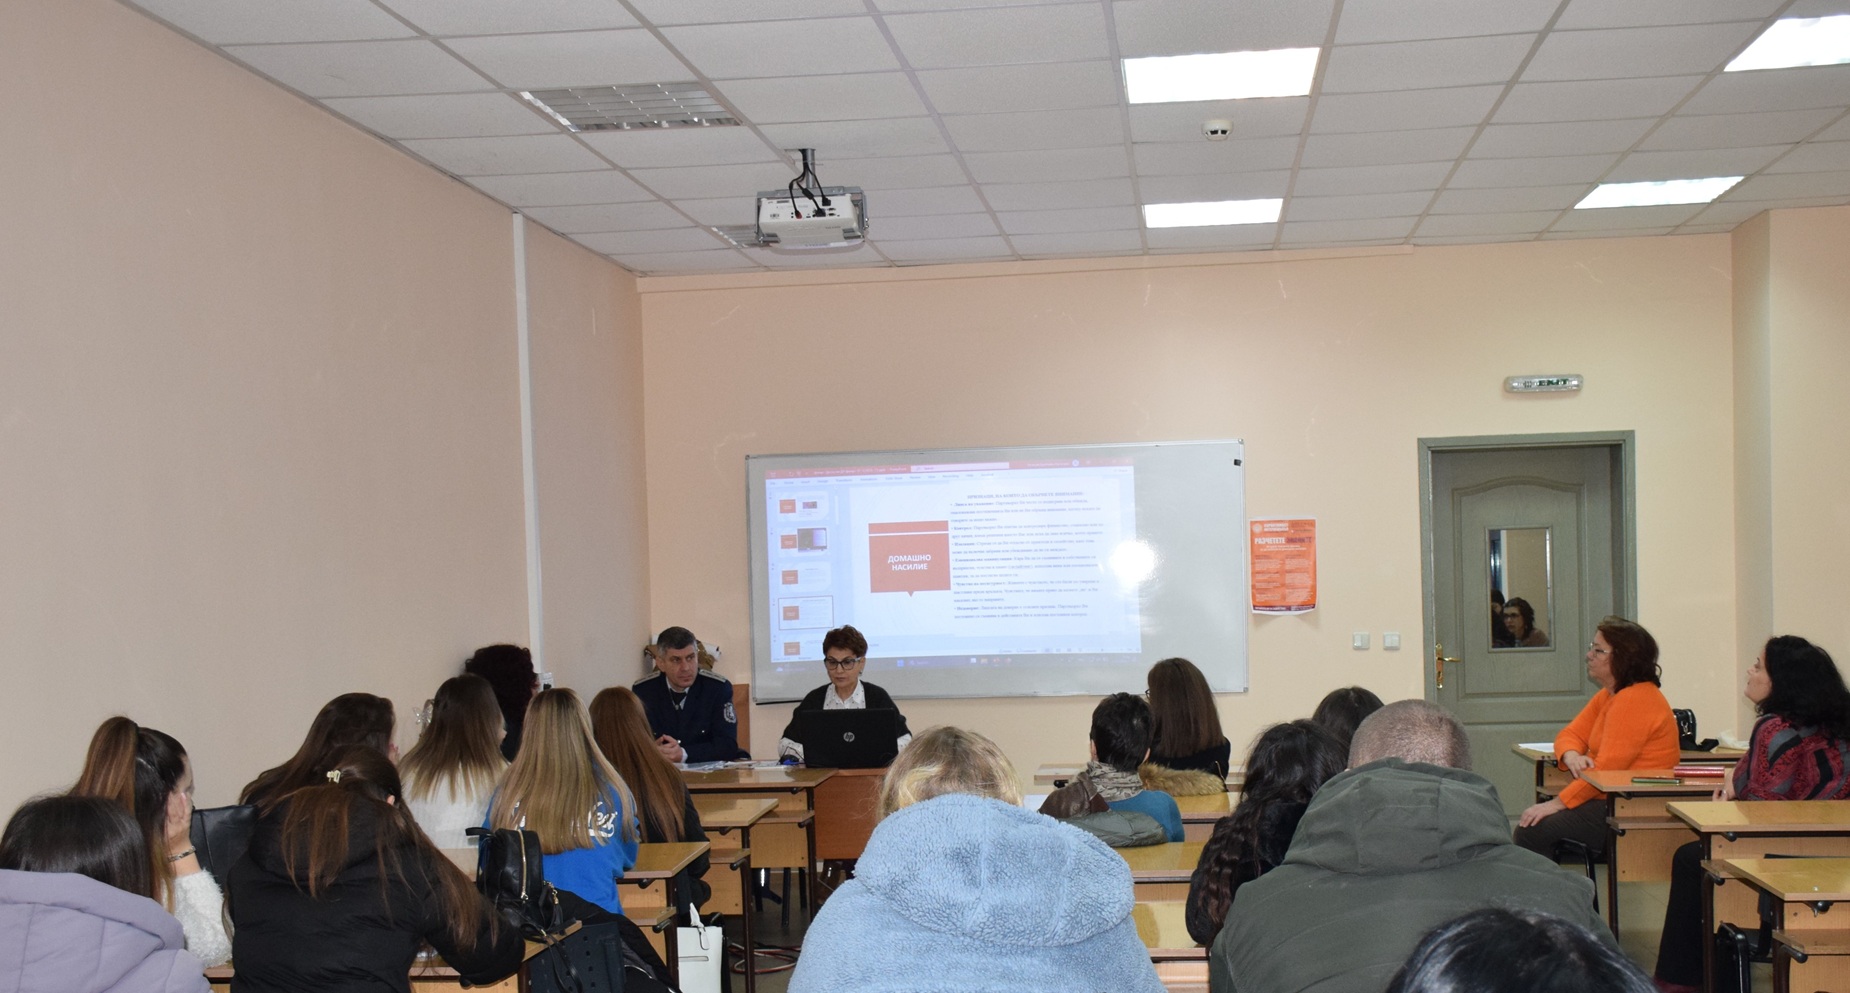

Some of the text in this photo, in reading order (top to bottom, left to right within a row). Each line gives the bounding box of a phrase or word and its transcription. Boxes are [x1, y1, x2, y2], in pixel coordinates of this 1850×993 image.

[1538, 378, 1569, 387] EXIT
[888, 554, 932, 564] ДОМАШНО
[891, 563, 929, 571] НАСИЛИЕ
[844, 732, 854, 742] hp
